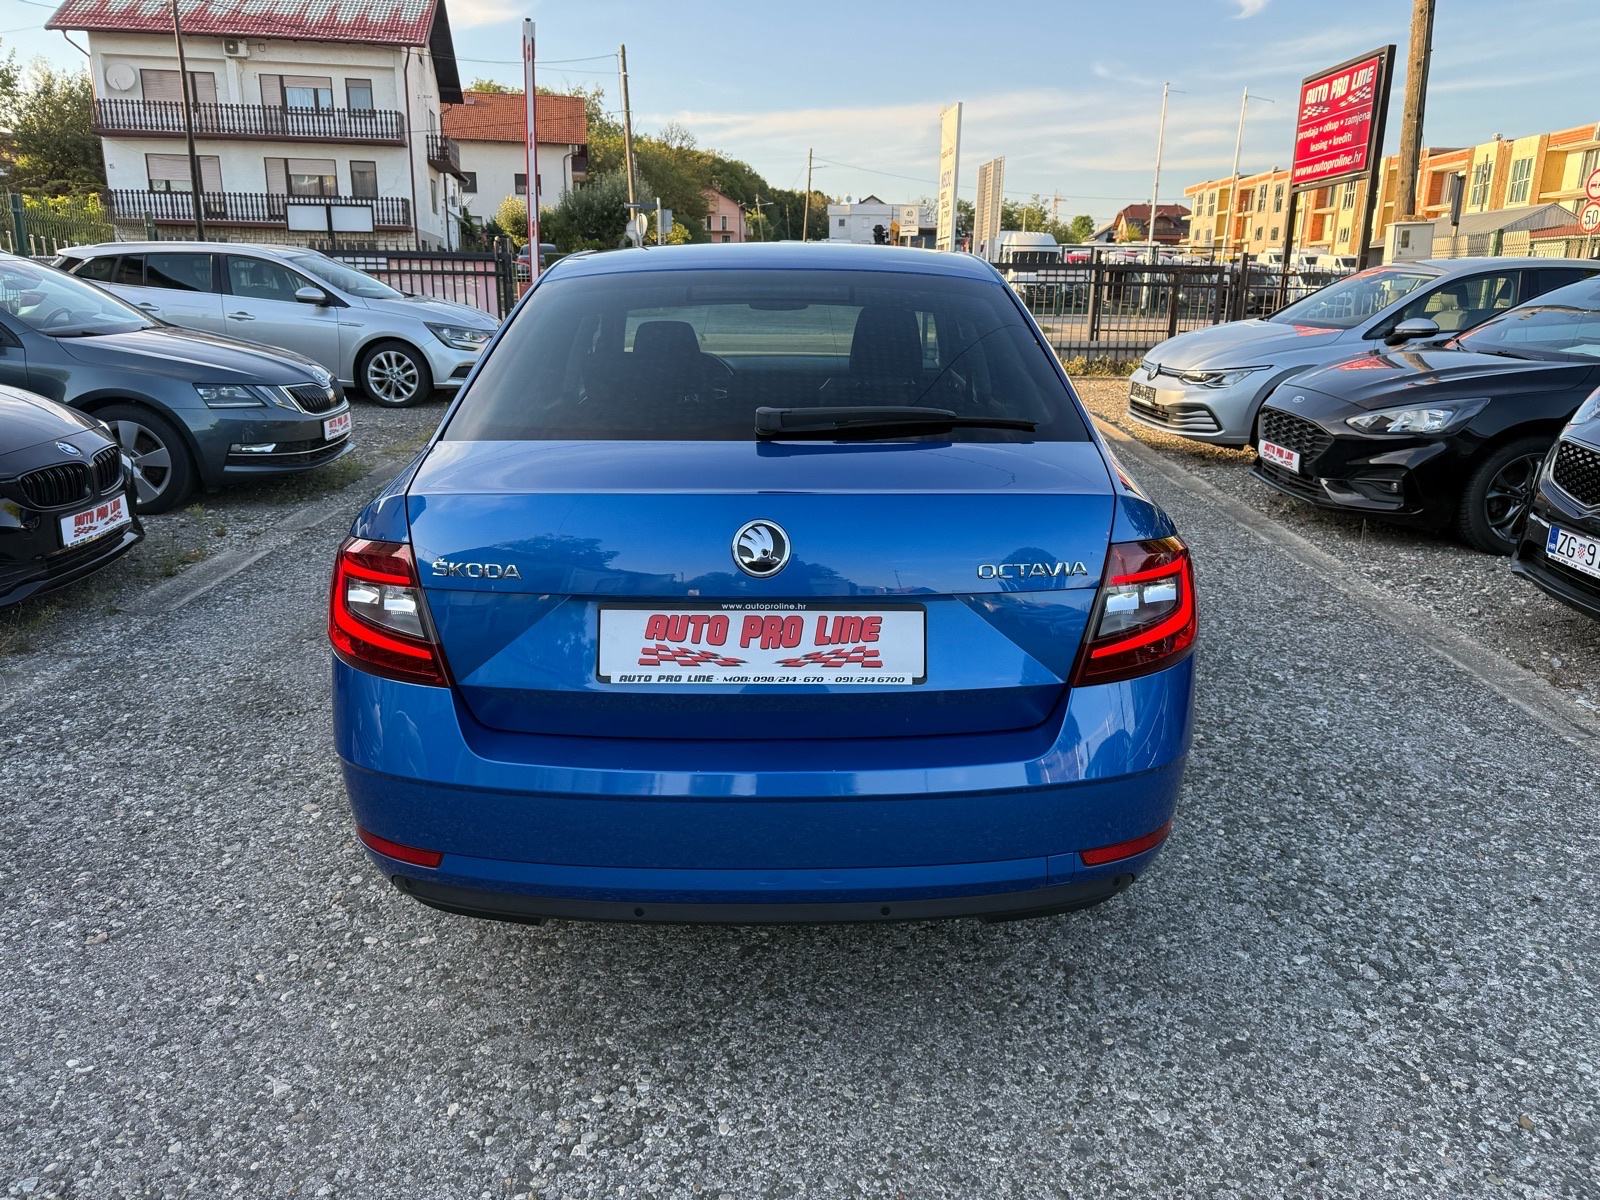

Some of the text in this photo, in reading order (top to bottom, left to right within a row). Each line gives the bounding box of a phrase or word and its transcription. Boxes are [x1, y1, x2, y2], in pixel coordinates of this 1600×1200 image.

[1305, 65, 1375, 105] AUTO PRO LINE
[1344, 111, 1371, 126] zamjena
[1295, 152, 1362, 176] www.autoproline.hr
[1585, 210, 1599, 225] 50
[75, 511, 95, 527] AUTO
[1557, 533, 1577, 558] ZG
[1585, 543, 1600, 569] 9
[432, 558, 522, 579] ŠKODA
[978, 561, 1088, 579] OCTAVIA
[721, 603, 807, 611] www.autoproline.hr
[645, 614, 883, 650] AUTO PRO LINE
[619, 675, 652, 683] AUTO
[657, 675, 682, 683] PRO
[687, 675, 714, 683] LINE
